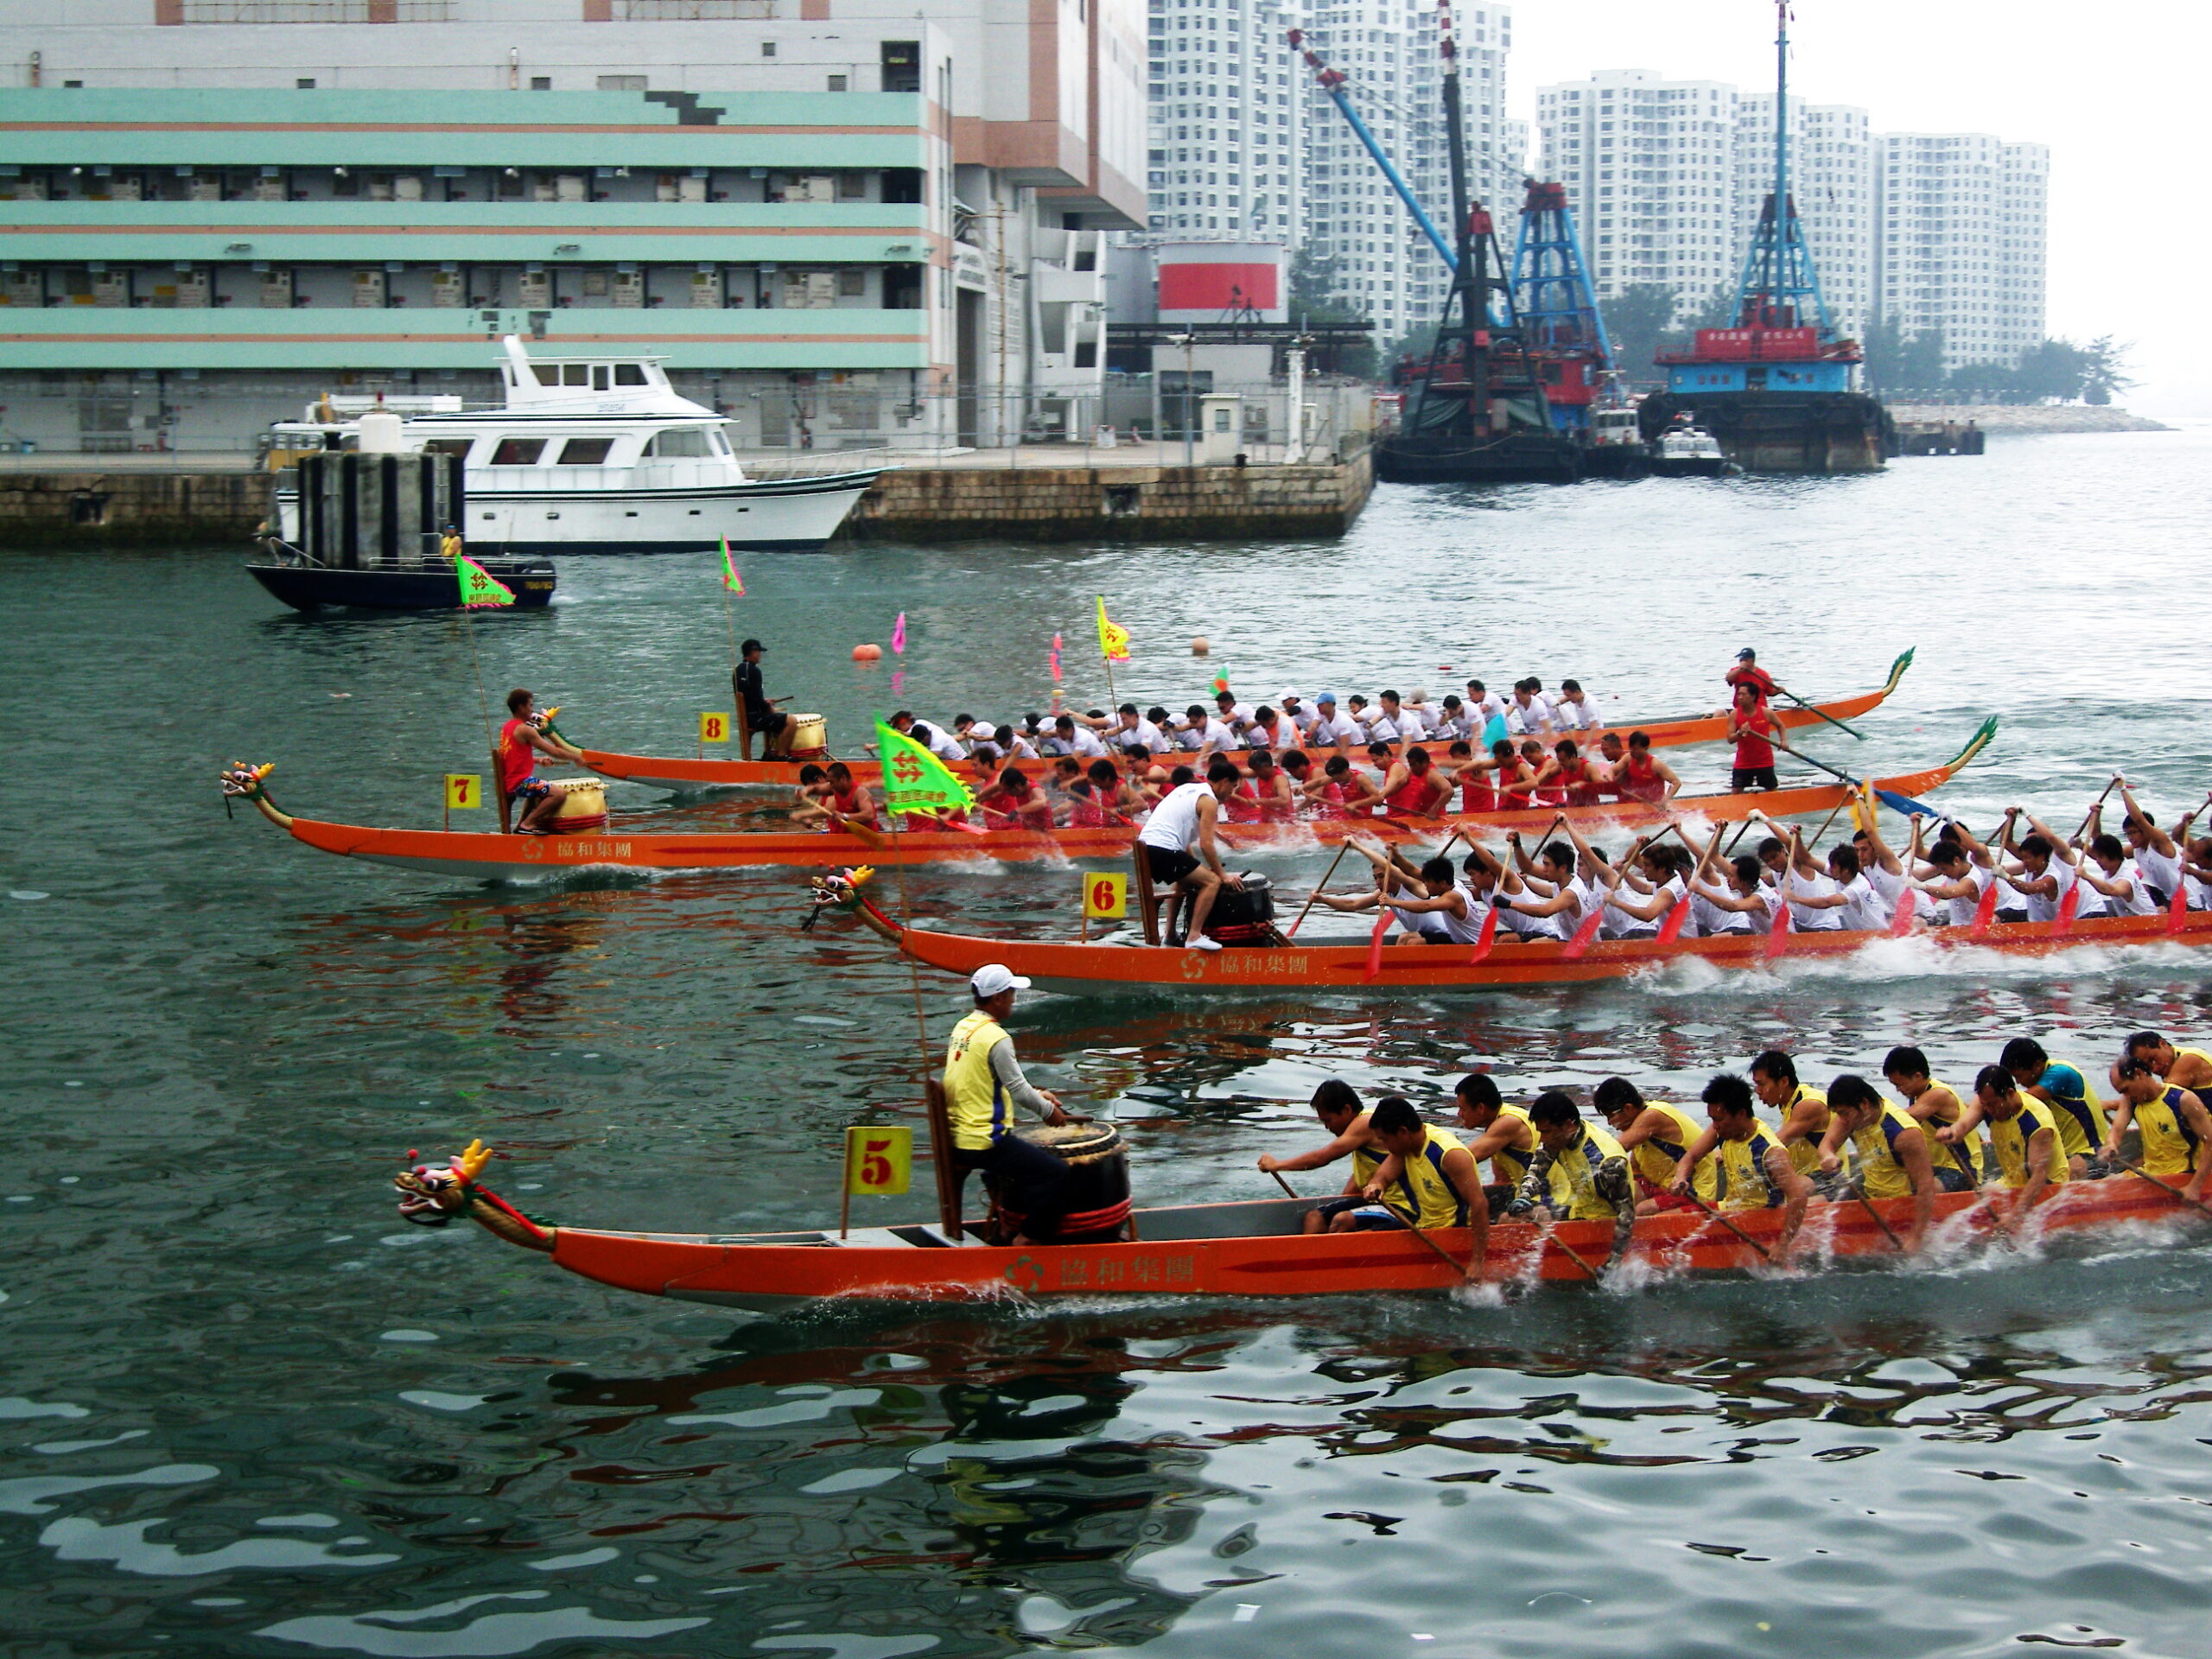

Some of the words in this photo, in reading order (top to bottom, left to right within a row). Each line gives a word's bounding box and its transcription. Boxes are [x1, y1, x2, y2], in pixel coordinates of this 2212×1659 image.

[706, 718, 721, 738] 8
[454, 779, 469, 803] 7
[557, 842, 631, 858] 協和集團
[1093, 880, 1115, 911] 6
[1220, 954, 1307, 975] 協和集團
[861, 1140, 892, 1185] 5
[1060, 1255, 1194, 1287] 協和集團
